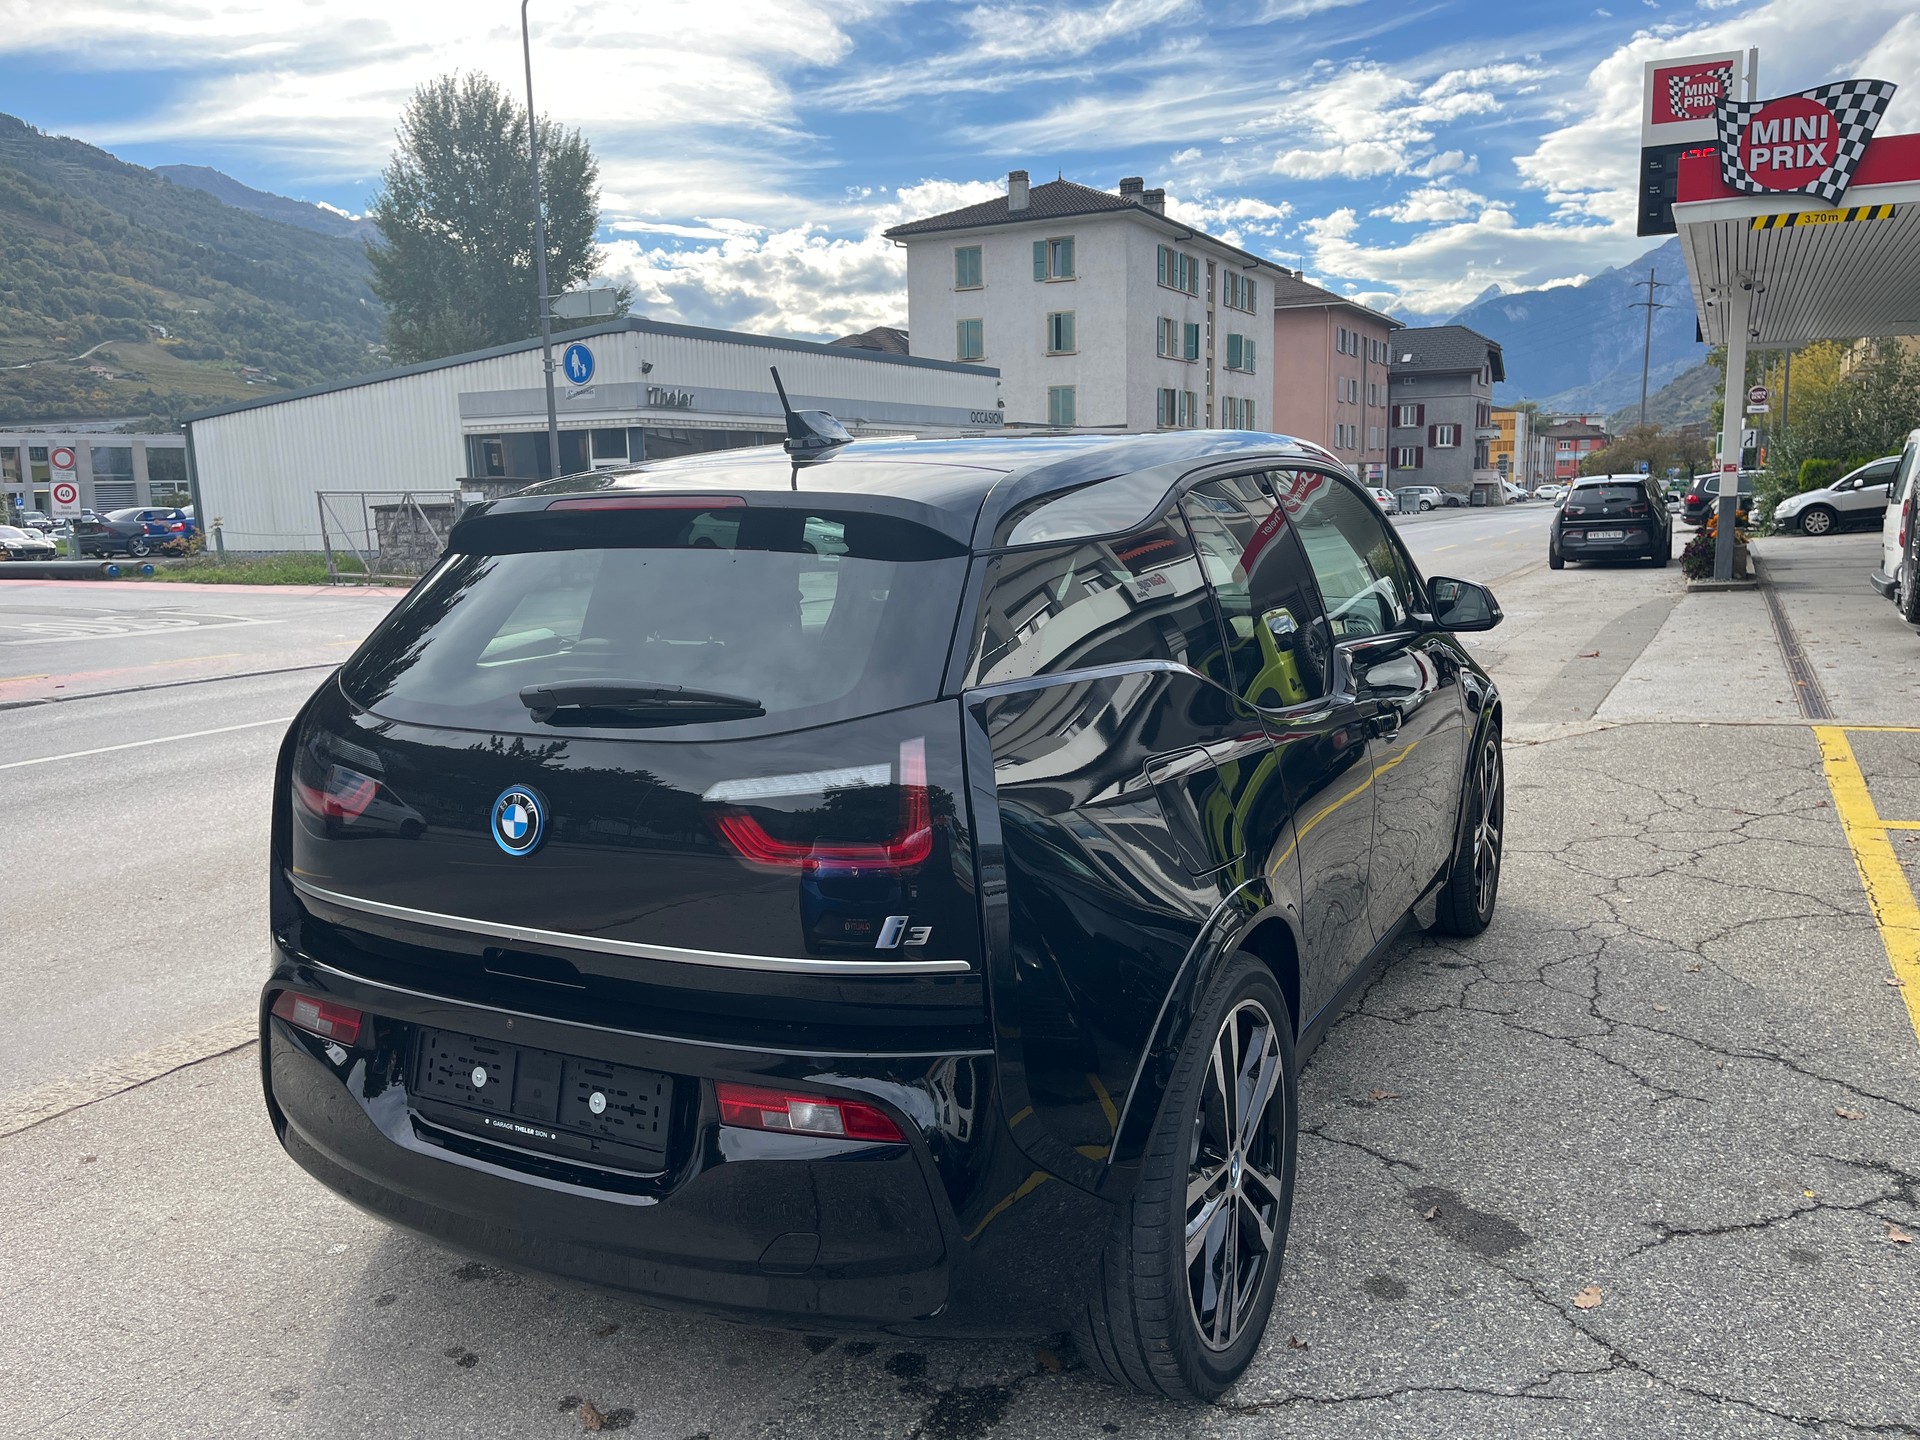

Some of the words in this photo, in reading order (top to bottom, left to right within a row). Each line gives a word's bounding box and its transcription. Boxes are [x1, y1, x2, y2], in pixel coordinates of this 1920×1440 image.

[1684, 82, 1718, 97] MINI
[1684, 94, 1718, 108] PRIX
[1751, 114, 1829, 146] MINI
[1750, 142, 1827, 172] PRIX
[647, 387, 695, 406] Theler
[970, 411, 1004, 424] OCCASION
[60, 489, 70, 498] 40
[875, 915, 933, 949] i3
[493, 1120, 513, 1130] GARAGE
[514, 1125, 534, 1135] THELER
[535, 1130, 548, 1138] SION
